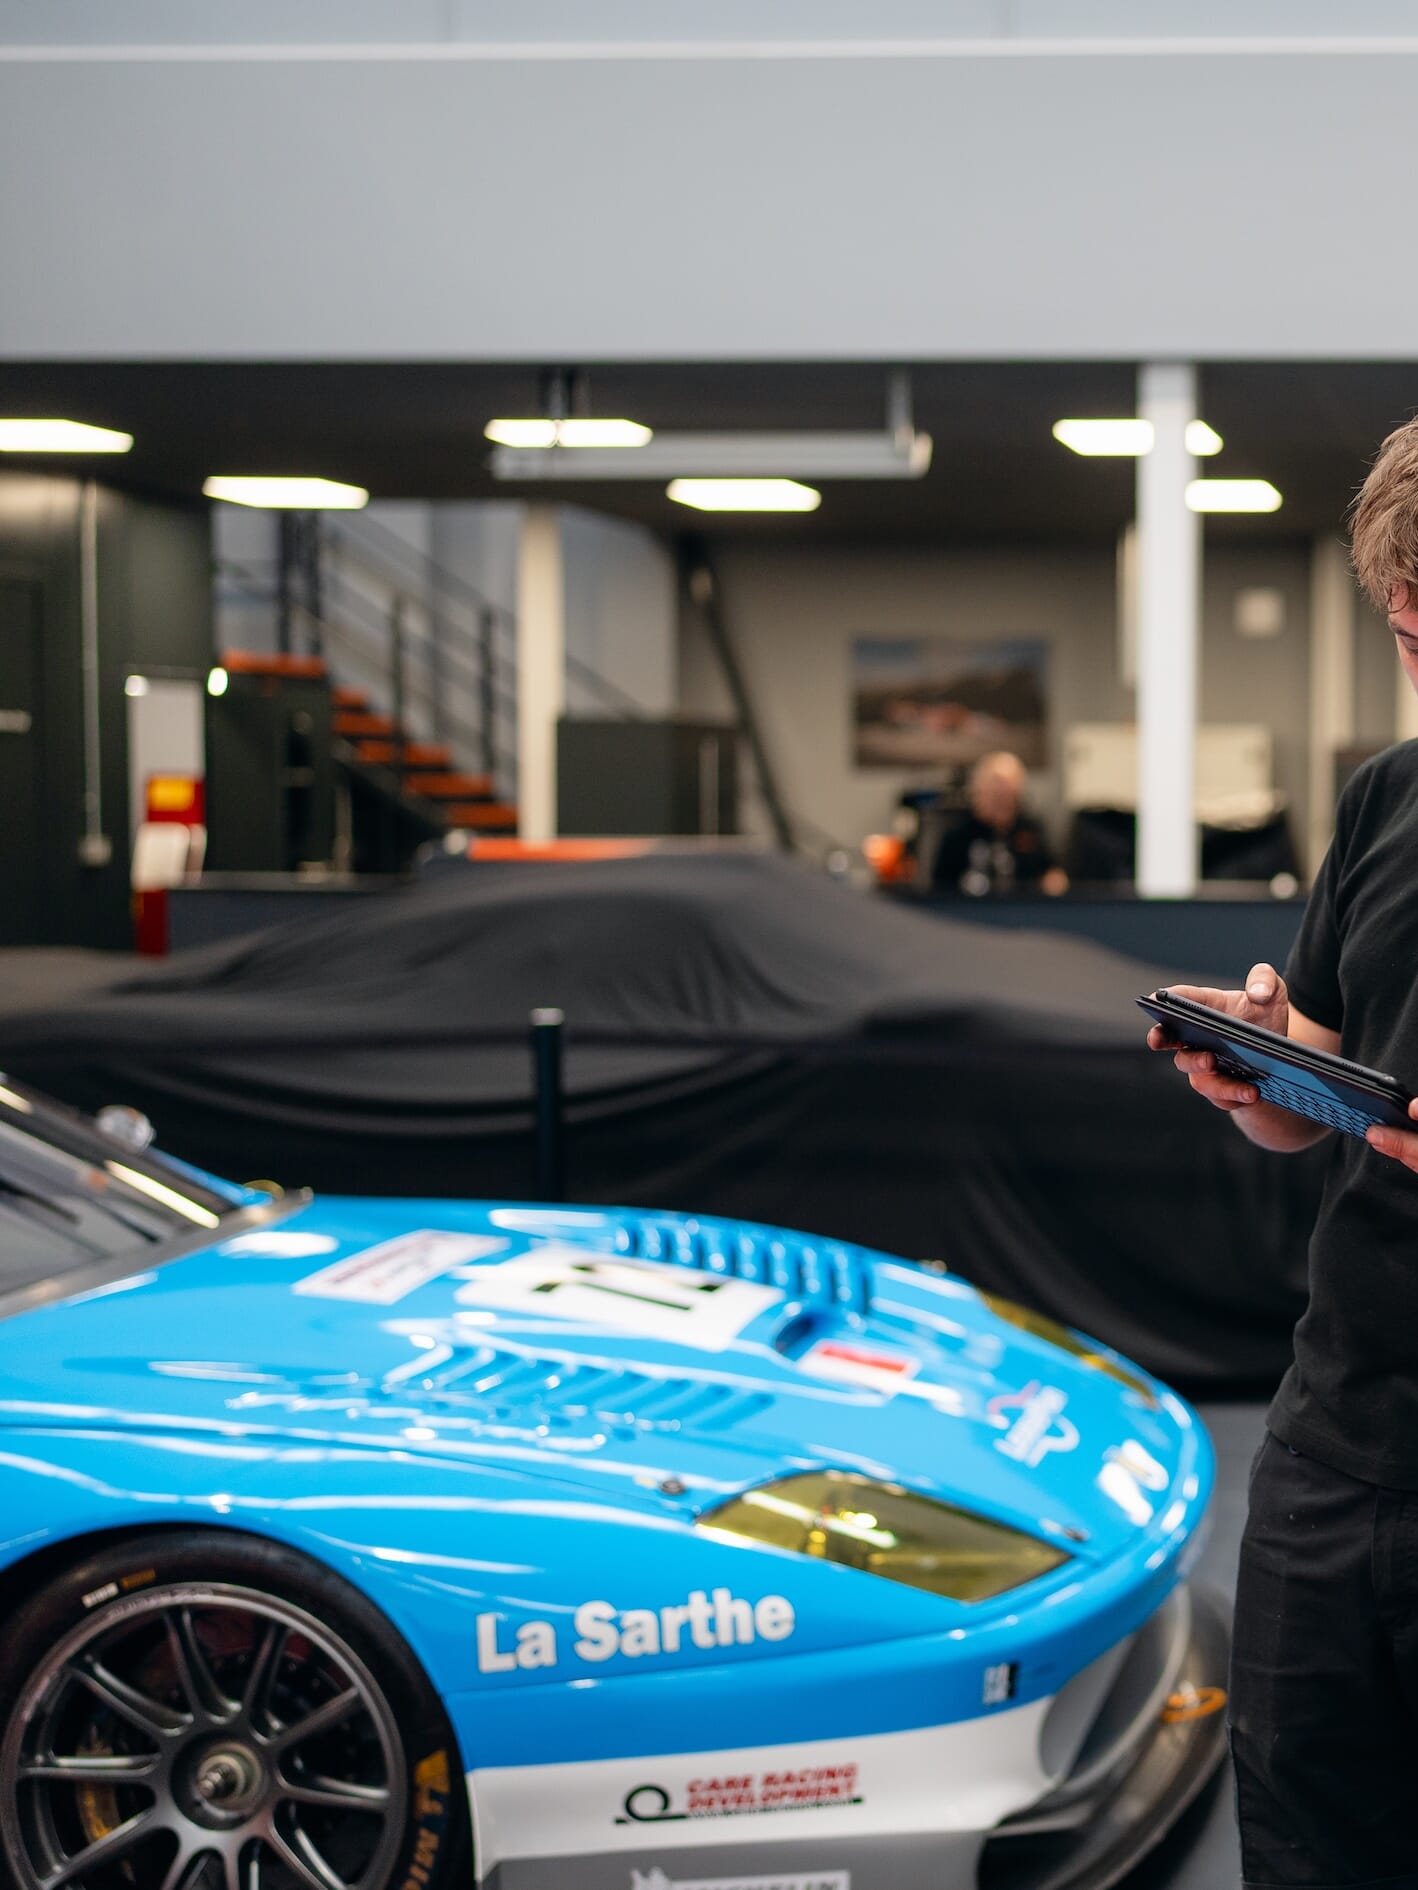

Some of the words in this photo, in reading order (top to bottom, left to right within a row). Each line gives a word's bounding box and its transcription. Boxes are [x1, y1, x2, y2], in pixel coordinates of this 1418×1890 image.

[477, 1612, 557, 1673] La
[574, 1588, 795, 1662] Sarthe
[763, 1764, 857, 1787] RACING
